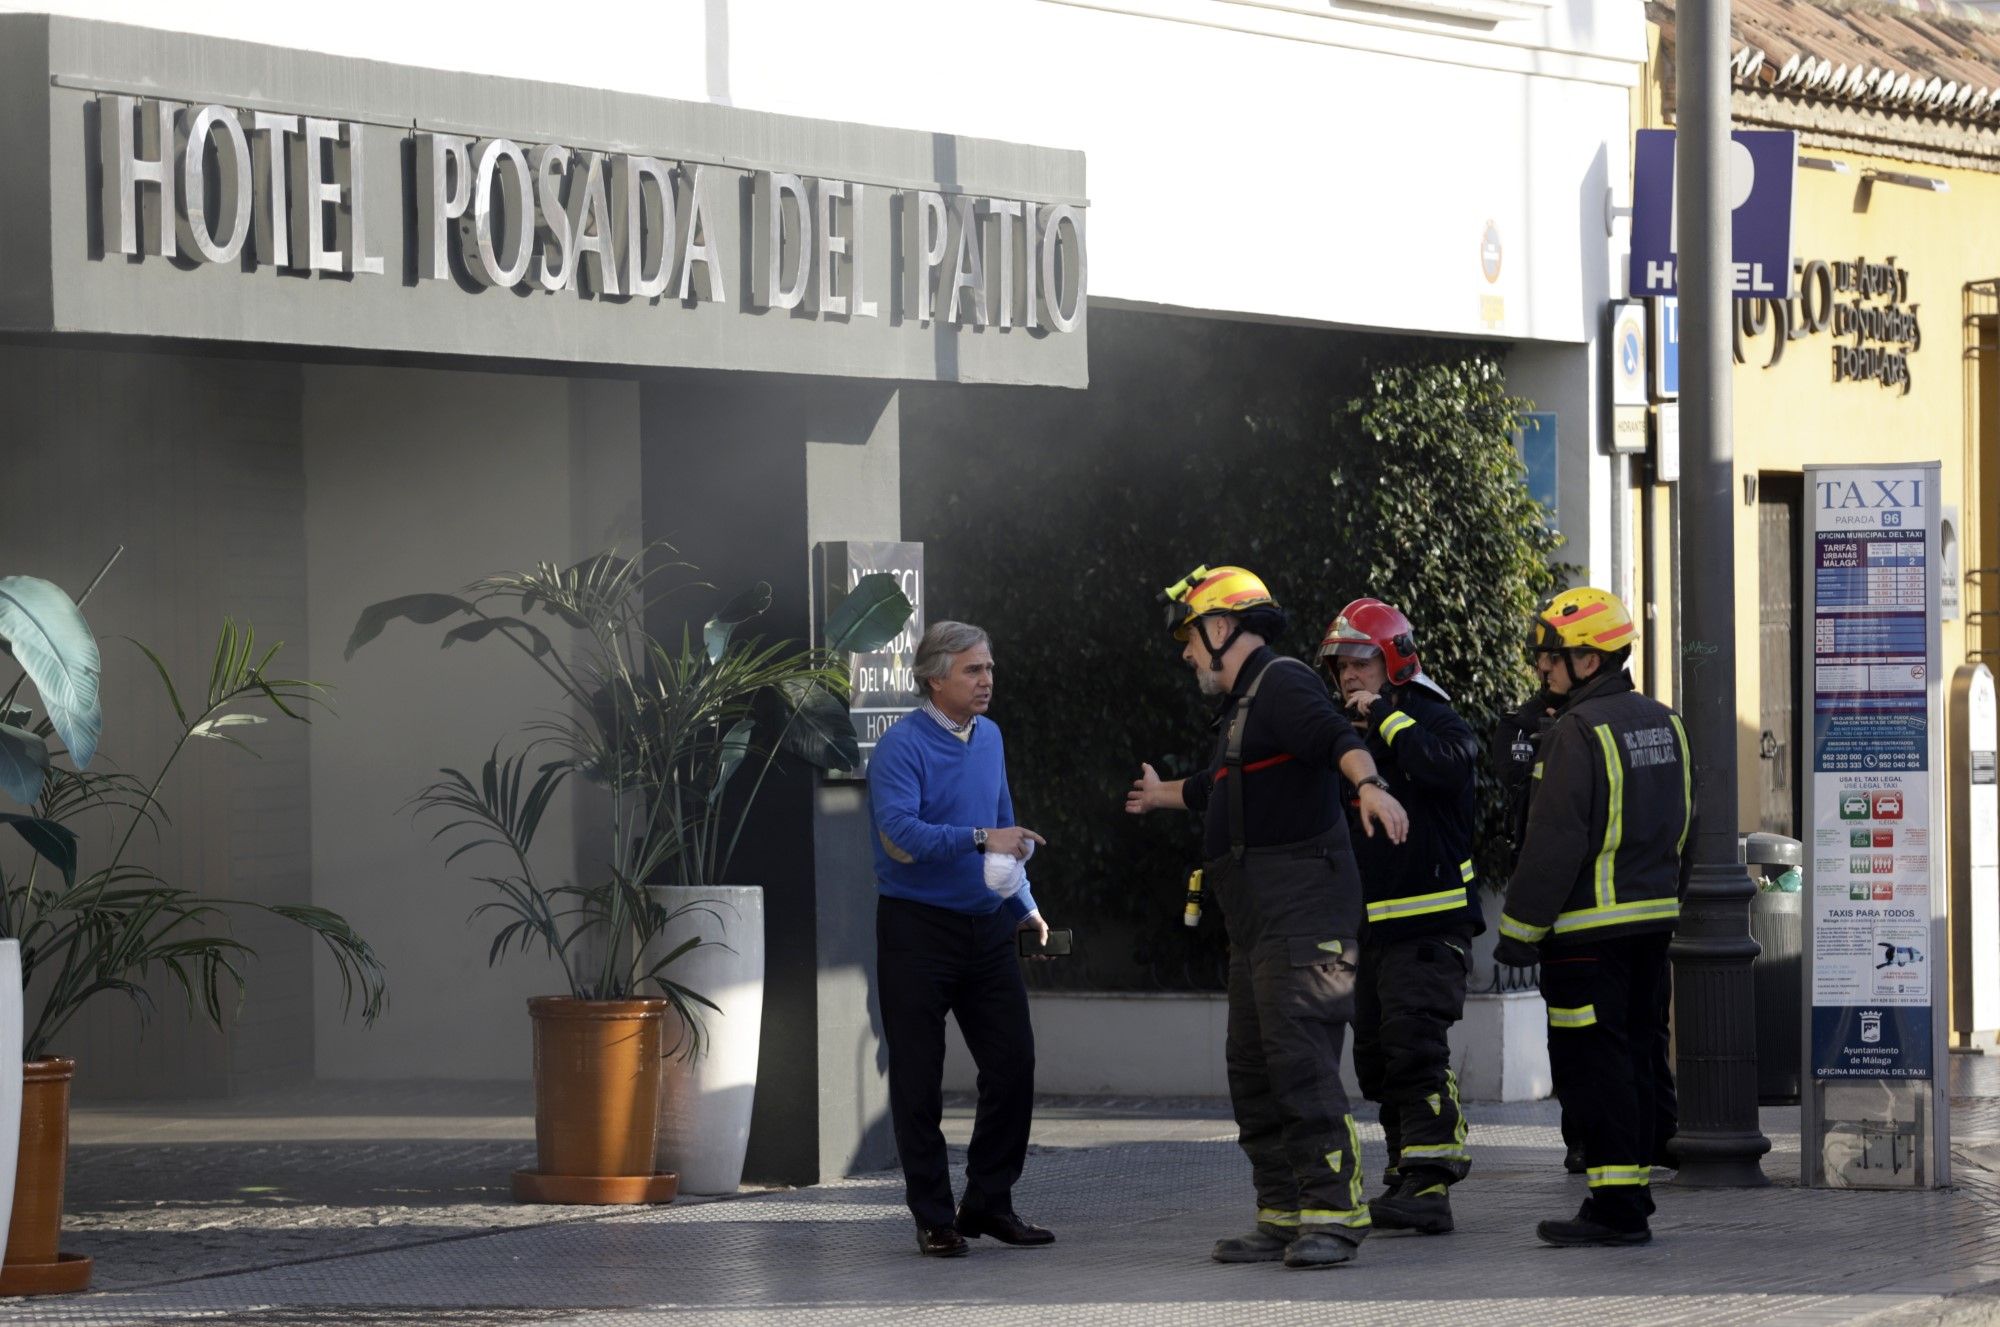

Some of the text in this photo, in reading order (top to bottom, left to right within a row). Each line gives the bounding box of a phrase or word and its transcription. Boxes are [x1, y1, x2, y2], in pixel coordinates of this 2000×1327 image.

[100, 95, 1088, 334] HOTEL POSADA DEL PATIO
[1646, 260, 1774, 292] HEL
[1816, 480, 1924, 509] TAXI
[1835, 513, 1900, 525] PARADA 96
[1818, 530, 1923, 540] OFICINA MUNICIPAL DEL TAXI
[1823, 544, 1858, 552] TARIFAS
[1909, 558, 1916, 567] 2
[859, 667, 914, 692] DEL PATIO
[867, 714, 904, 739] HOT
[1828, 910, 1914, 918] TAXIS PARA TODOS
[1844, 1046, 1899, 1055] Ayuntamiento
[1862, 1056, 1892, 1065] Málaga
